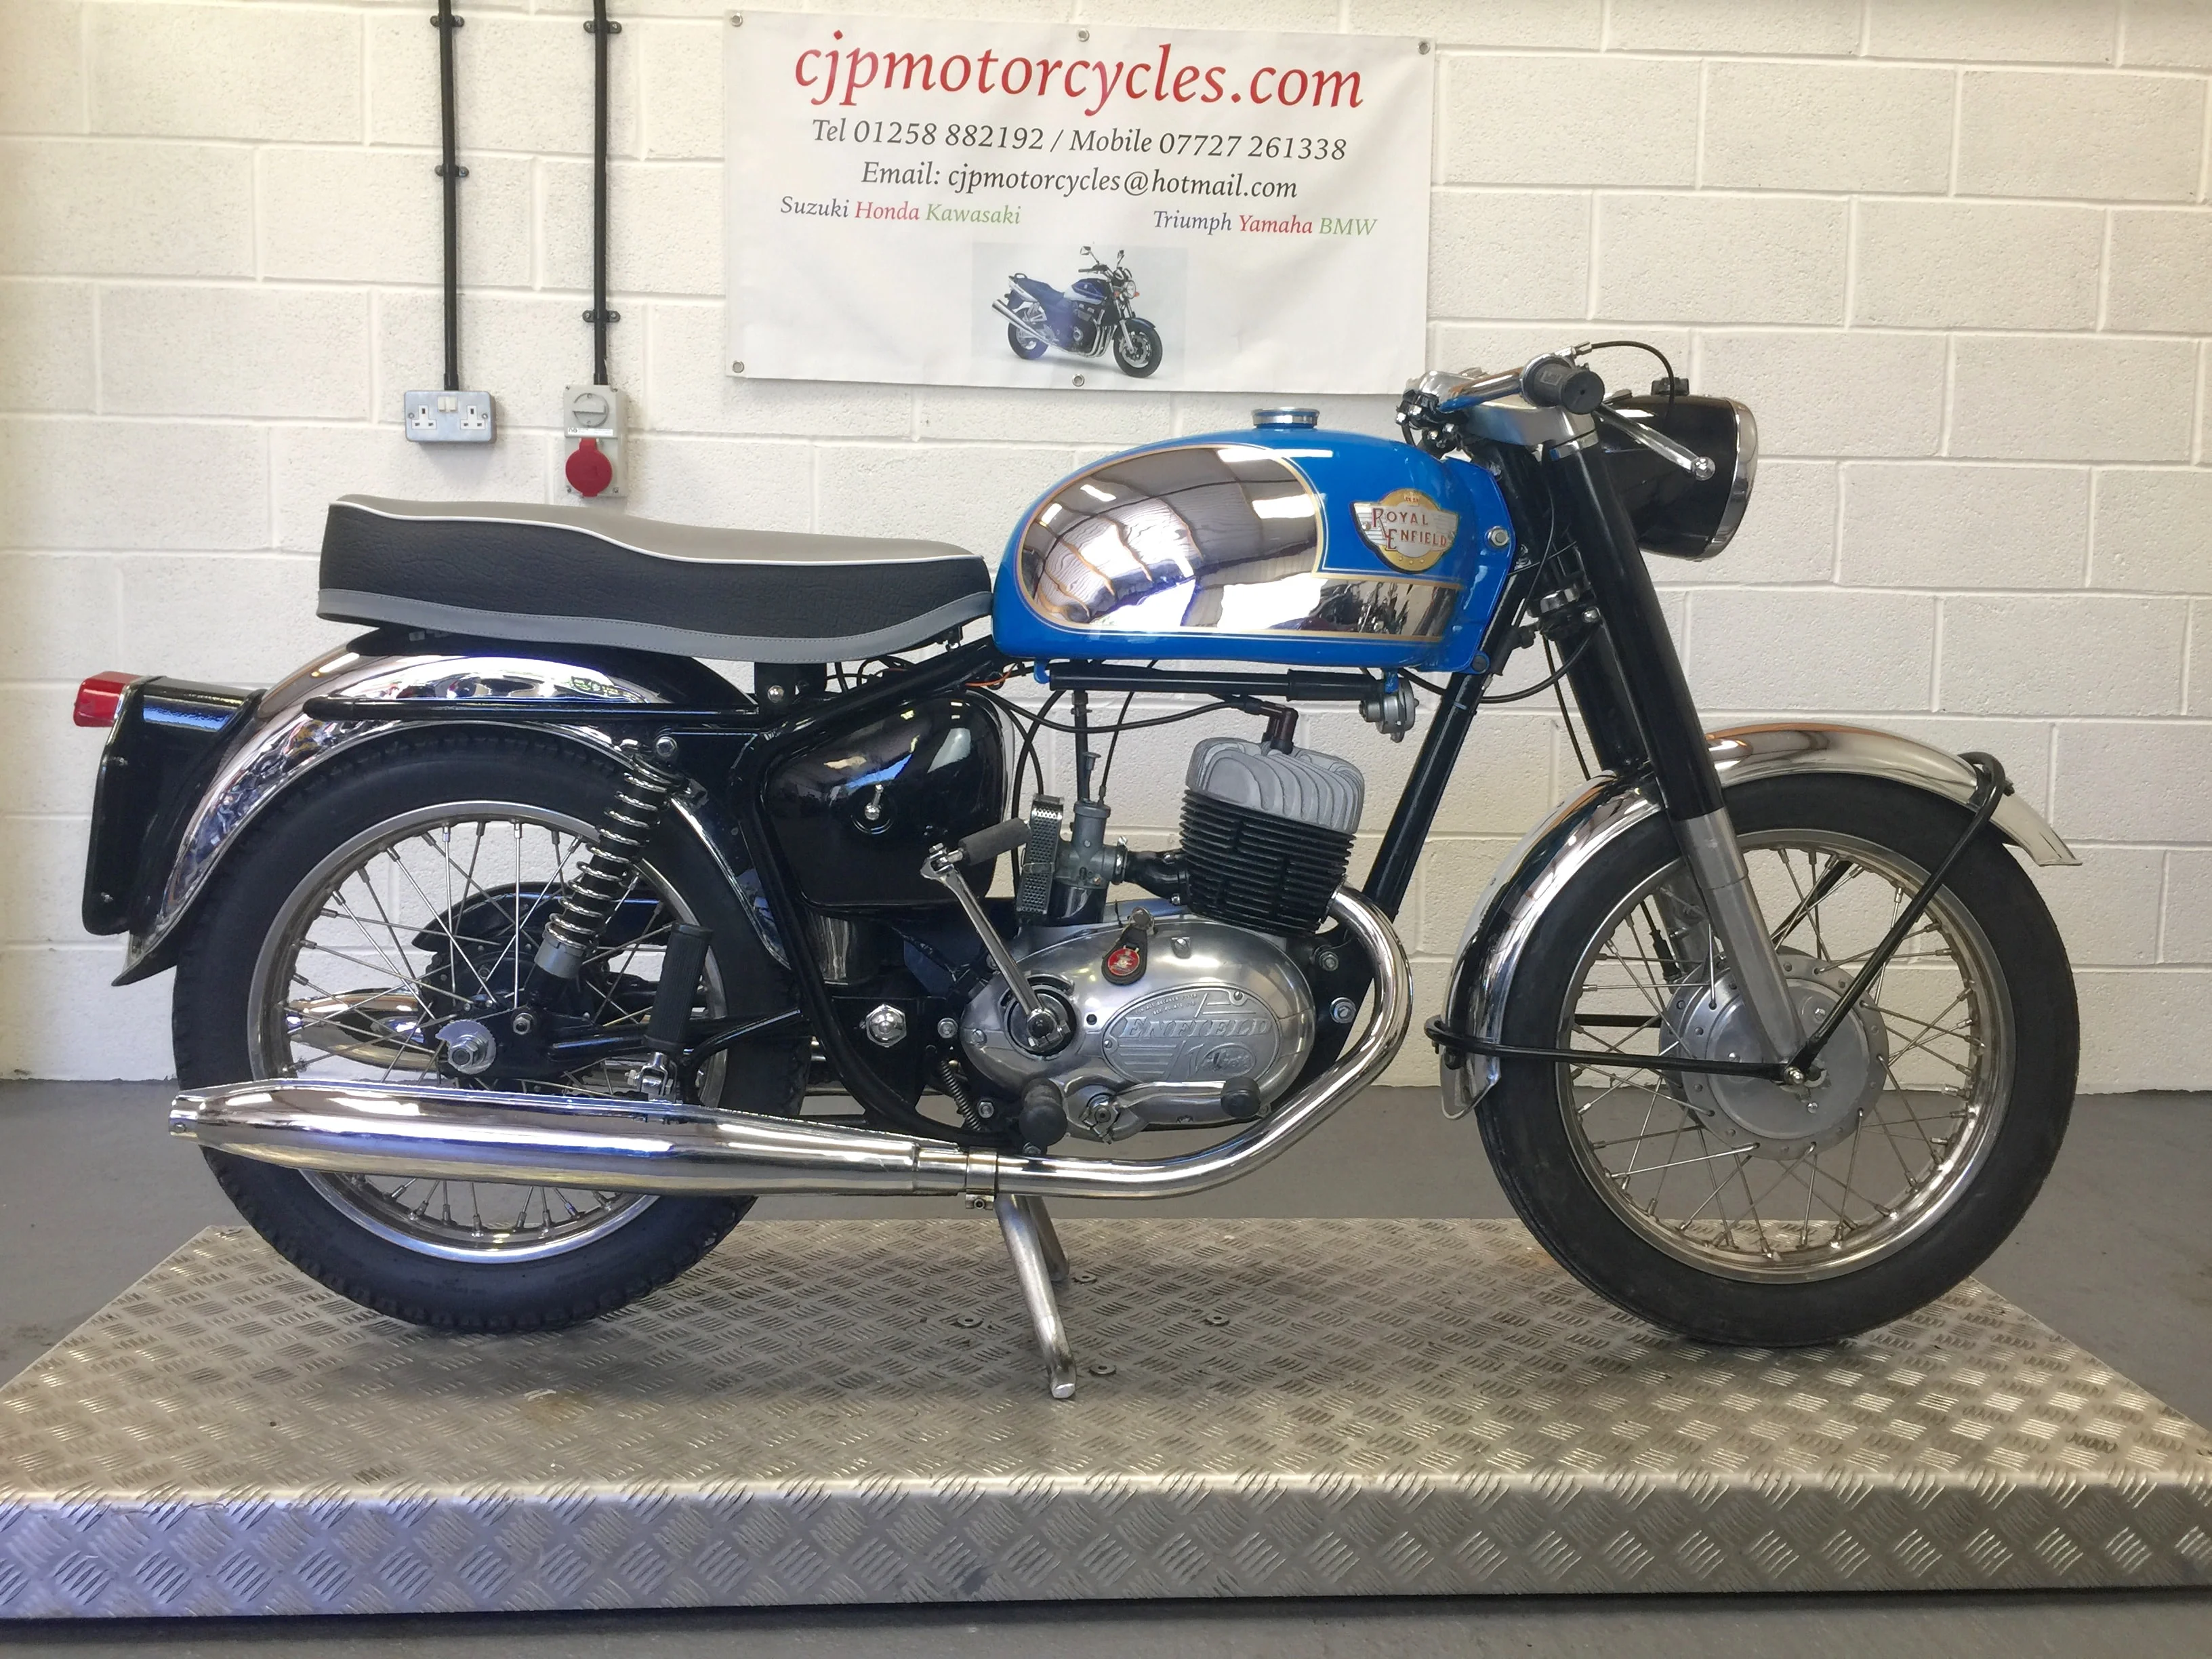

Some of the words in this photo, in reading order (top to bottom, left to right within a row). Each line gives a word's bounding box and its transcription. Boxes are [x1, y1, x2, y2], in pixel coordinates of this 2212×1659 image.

[795, 30, 1364, 117] cjpmotorcycles.com
[813, 118, 846, 142] Tel
[854, 121, 937, 146] 01258
[945, 124, 1044, 150] 882192
[1050, 129, 1065, 153] /
[1068, 127, 1153, 153] Mobile
[1160, 133, 1242, 157] 07727
[1248, 136, 1347, 161] 261338
[861, 161, 941, 186] Email:
[947, 163, 1298, 199] cjpmotorcycles@hotmail.com
[781, 196, 850, 220] Suzuki
[854, 201, 921, 222] Honda
[925, 204, 1022, 226] Kawasaki
[1153, 210, 1232, 237] Triumph
[1239, 214, 1313, 234] Yamaha
[1319, 217, 1378, 237] BMW
[1372, 508, 1429, 530] ROYAL
[1387, 529, 1448, 551] ENFIELD
[1118, 1016, 1272, 1039] ENFIELD
